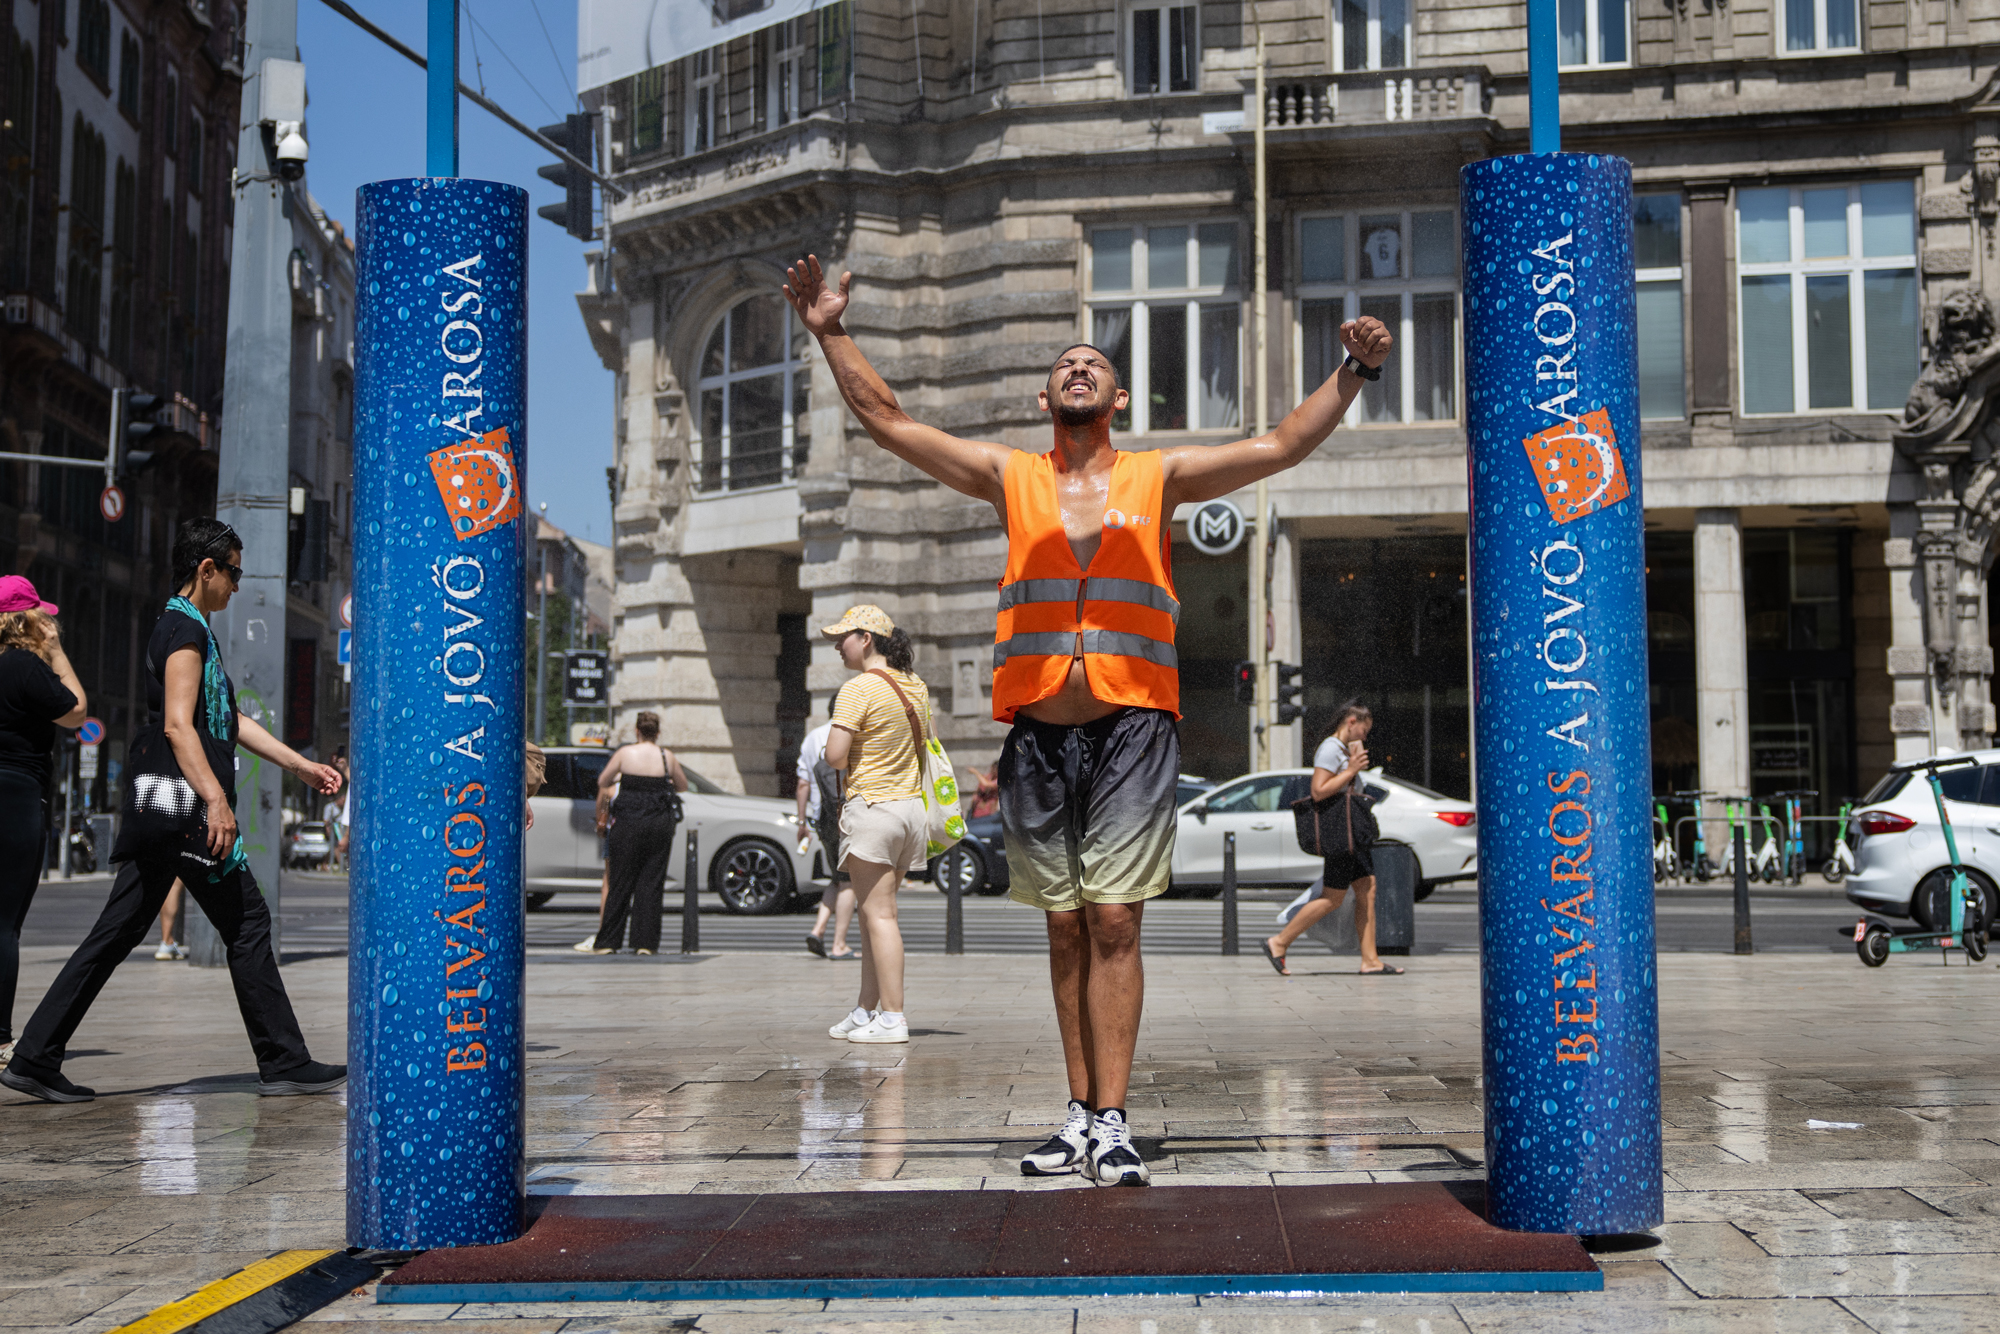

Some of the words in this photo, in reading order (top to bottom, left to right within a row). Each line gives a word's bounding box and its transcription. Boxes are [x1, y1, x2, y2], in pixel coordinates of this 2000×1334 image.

[1379, 243, 1389, 261] 6
[1132, 515, 1151, 526] FKF
[1200, 510, 1231, 541] M
[431, 555, 495, 710] JÖVŐ
[1530, 540, 1600, 697] JÖVŐ
[443, 726, 485, 766] A
[1546, 711, 1589, 753] A
[433, 782, 487, 1076] BELVÁROS
[1540, 770, 1598, 1066] BELVÁROS
